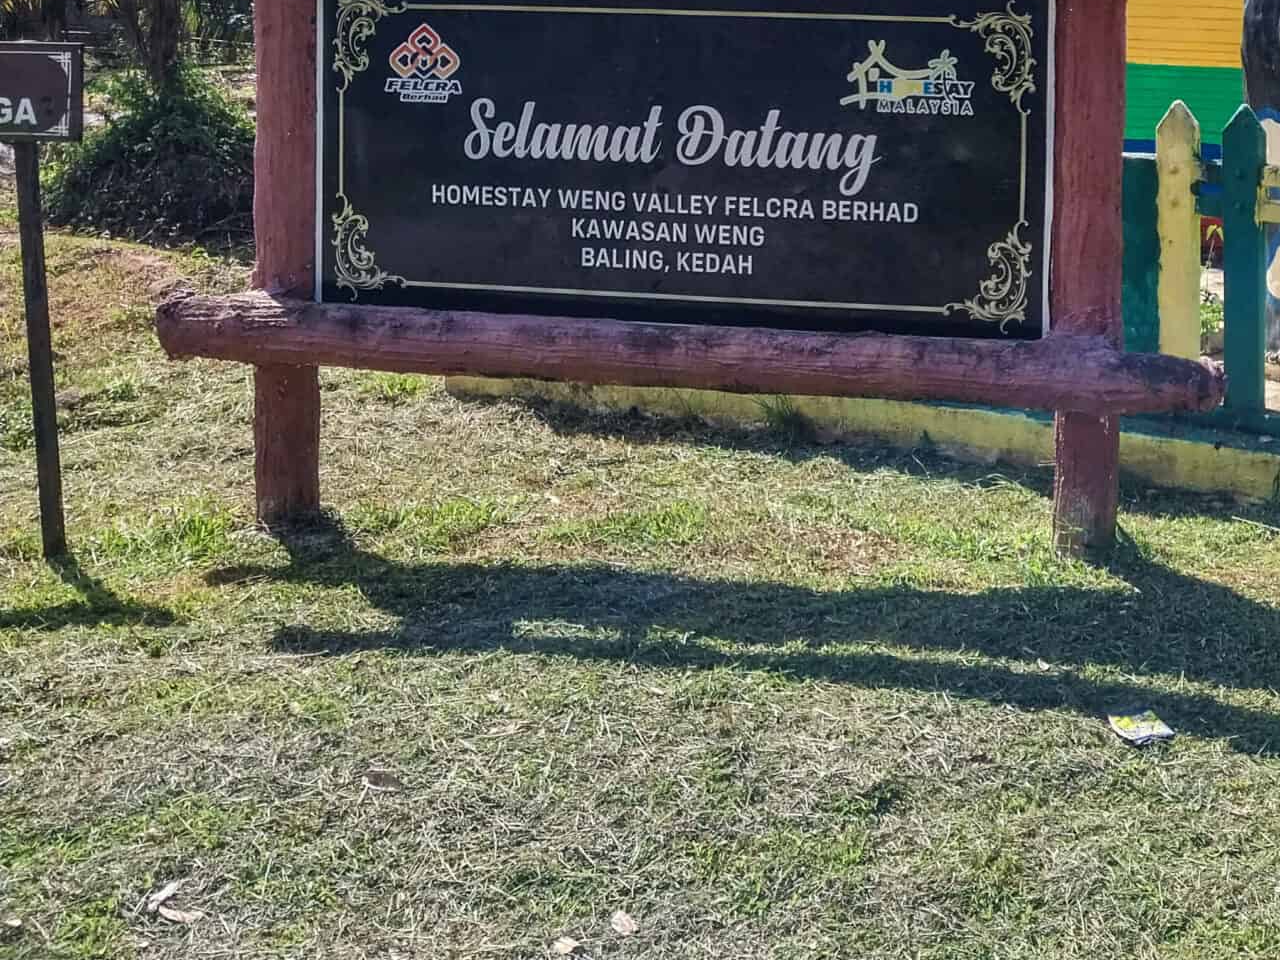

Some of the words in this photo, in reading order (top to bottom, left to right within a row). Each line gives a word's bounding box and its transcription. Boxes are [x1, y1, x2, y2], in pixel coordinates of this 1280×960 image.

[384, 78, 462, 94] FELCRA
[878, 79, 975, 98] HESAY
[877, 98, 974, 115] MALAYSIA
[464, 98, 662, 163] Selamat
[676, 105, 882, 196] Datang
[432, 184, 551, 208] HOMESTAY
[558, 189, 625, 211] WENG
[632, 192, 717, 215] VALLEY
[725, 197, 814, 219] FELCRA
[823, 200, 917, 222] BERHAD
[572, 218, 686, 242] KAWASAN
[695, 224, 764, 246] WENG
[582, 248, 669, 272] BALING,
[677, 252, 752, 274] KEDAH
